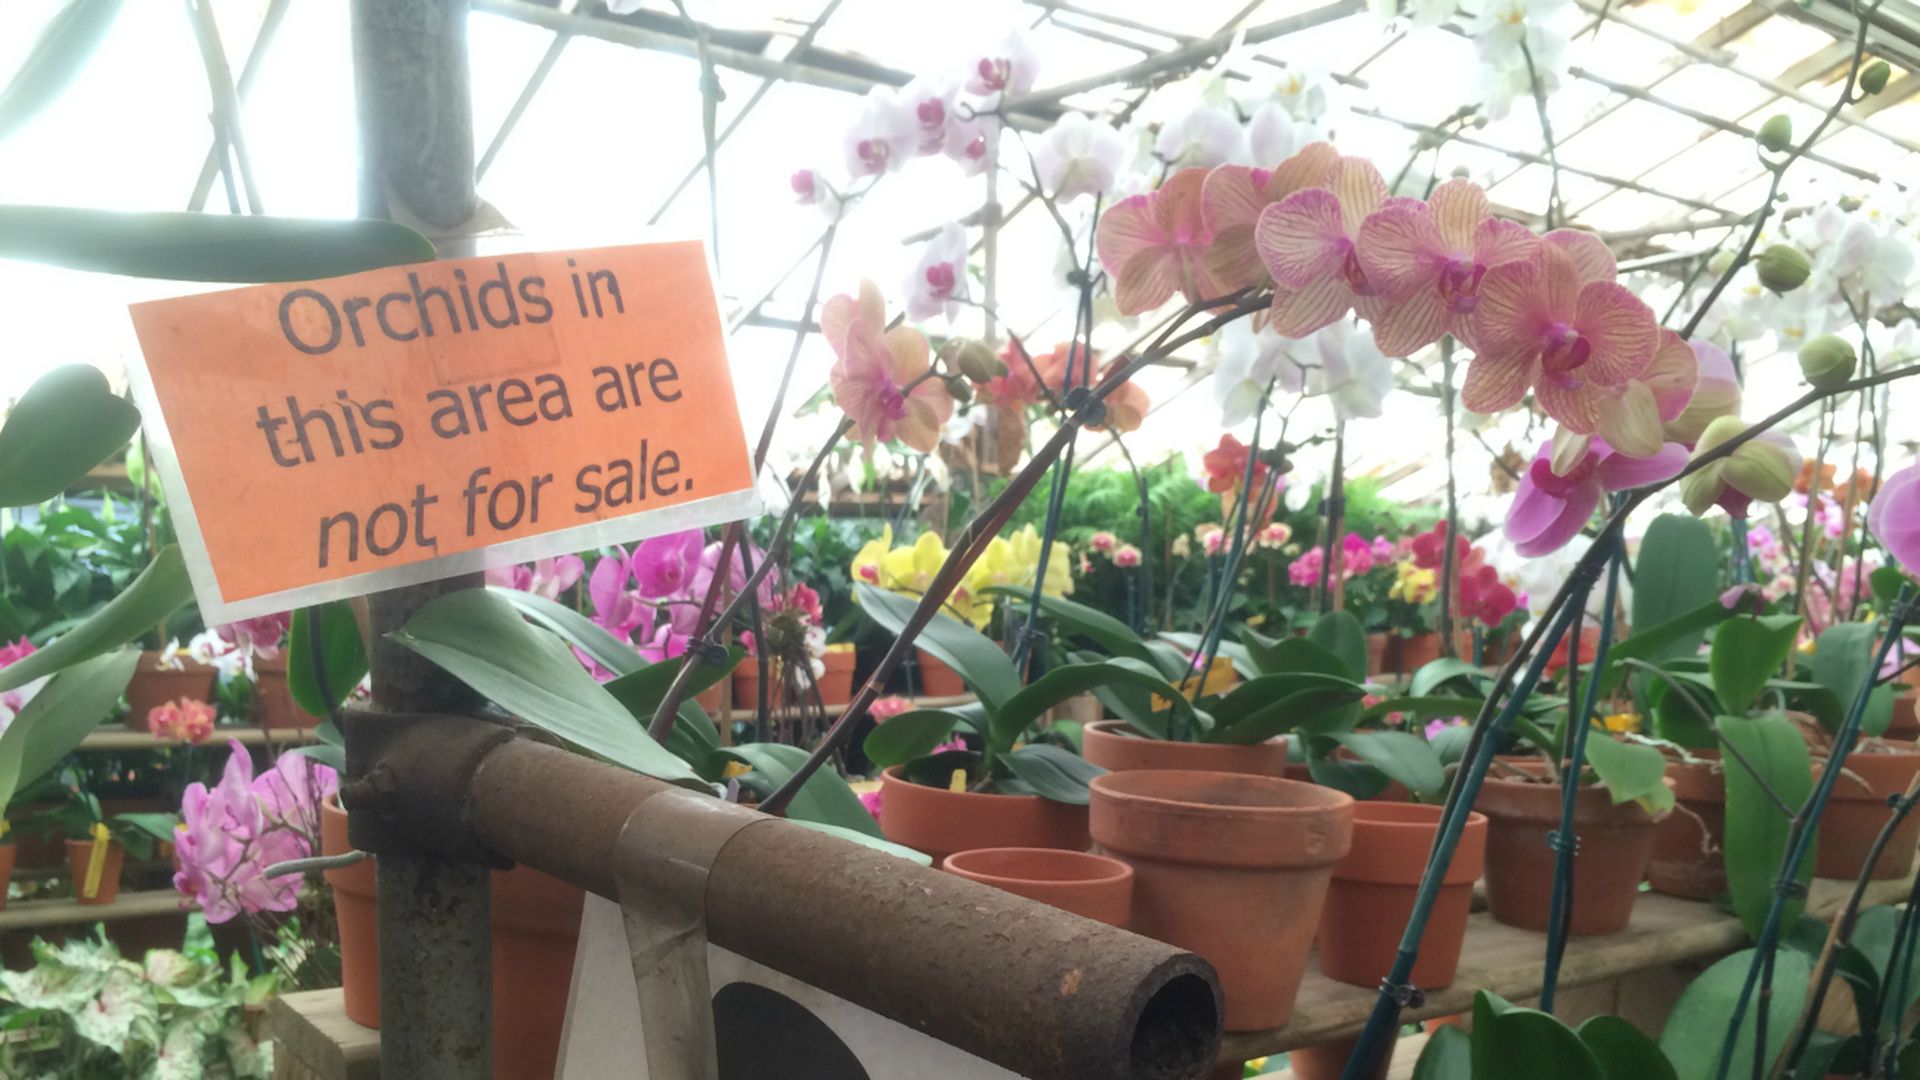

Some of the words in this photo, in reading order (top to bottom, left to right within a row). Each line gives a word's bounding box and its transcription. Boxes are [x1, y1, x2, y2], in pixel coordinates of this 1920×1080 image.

[278, 262, 554, 356] Orchids
[566, 258, 625, 319] in
[255, 390, 404, 468] this
[426, 372, 573, 440] area
[592, 357, 683, 413] are
[318, 483, 439, 569] not
[462, 467, 553, 537] for
[574, 439, 694, 514] sale.
